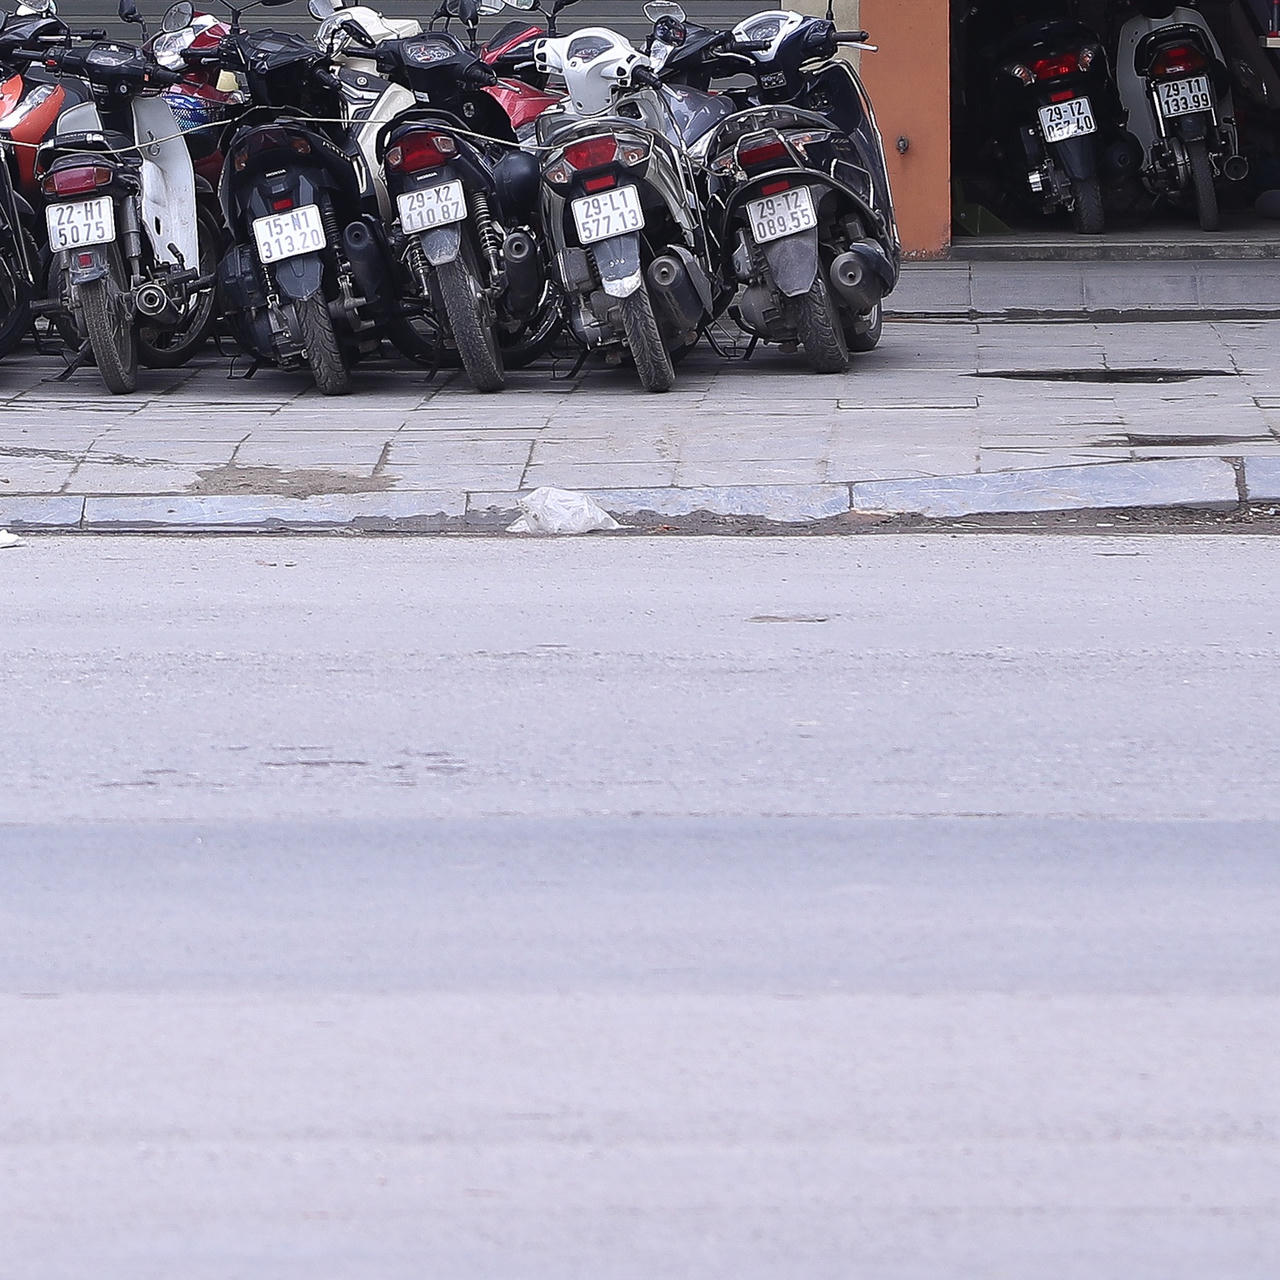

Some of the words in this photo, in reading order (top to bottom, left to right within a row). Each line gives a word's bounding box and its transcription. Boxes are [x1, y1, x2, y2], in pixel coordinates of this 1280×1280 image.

[1164, 78, 1203, 99] 29-T1
[1046, 101, 1085, 123] 29-T2
[1163, 92, 1211, 115] 133.99
[406, 185, 453, 212] 29-X2
[582, 190, 628, 219] 29-L1
[756, 191, 802, 219] 29-T2
[55, 200, 103, 226] 22-H1
[265, 210, 310, 238] 15-N1
[406, 201, 461, 229] 110.87
[581, 209, 639, 239] 577.13
[756, 208, 812, 239] 089.55
[58, 221, 106, 247] 5075
[262, 228, 321, 259] 313.20
